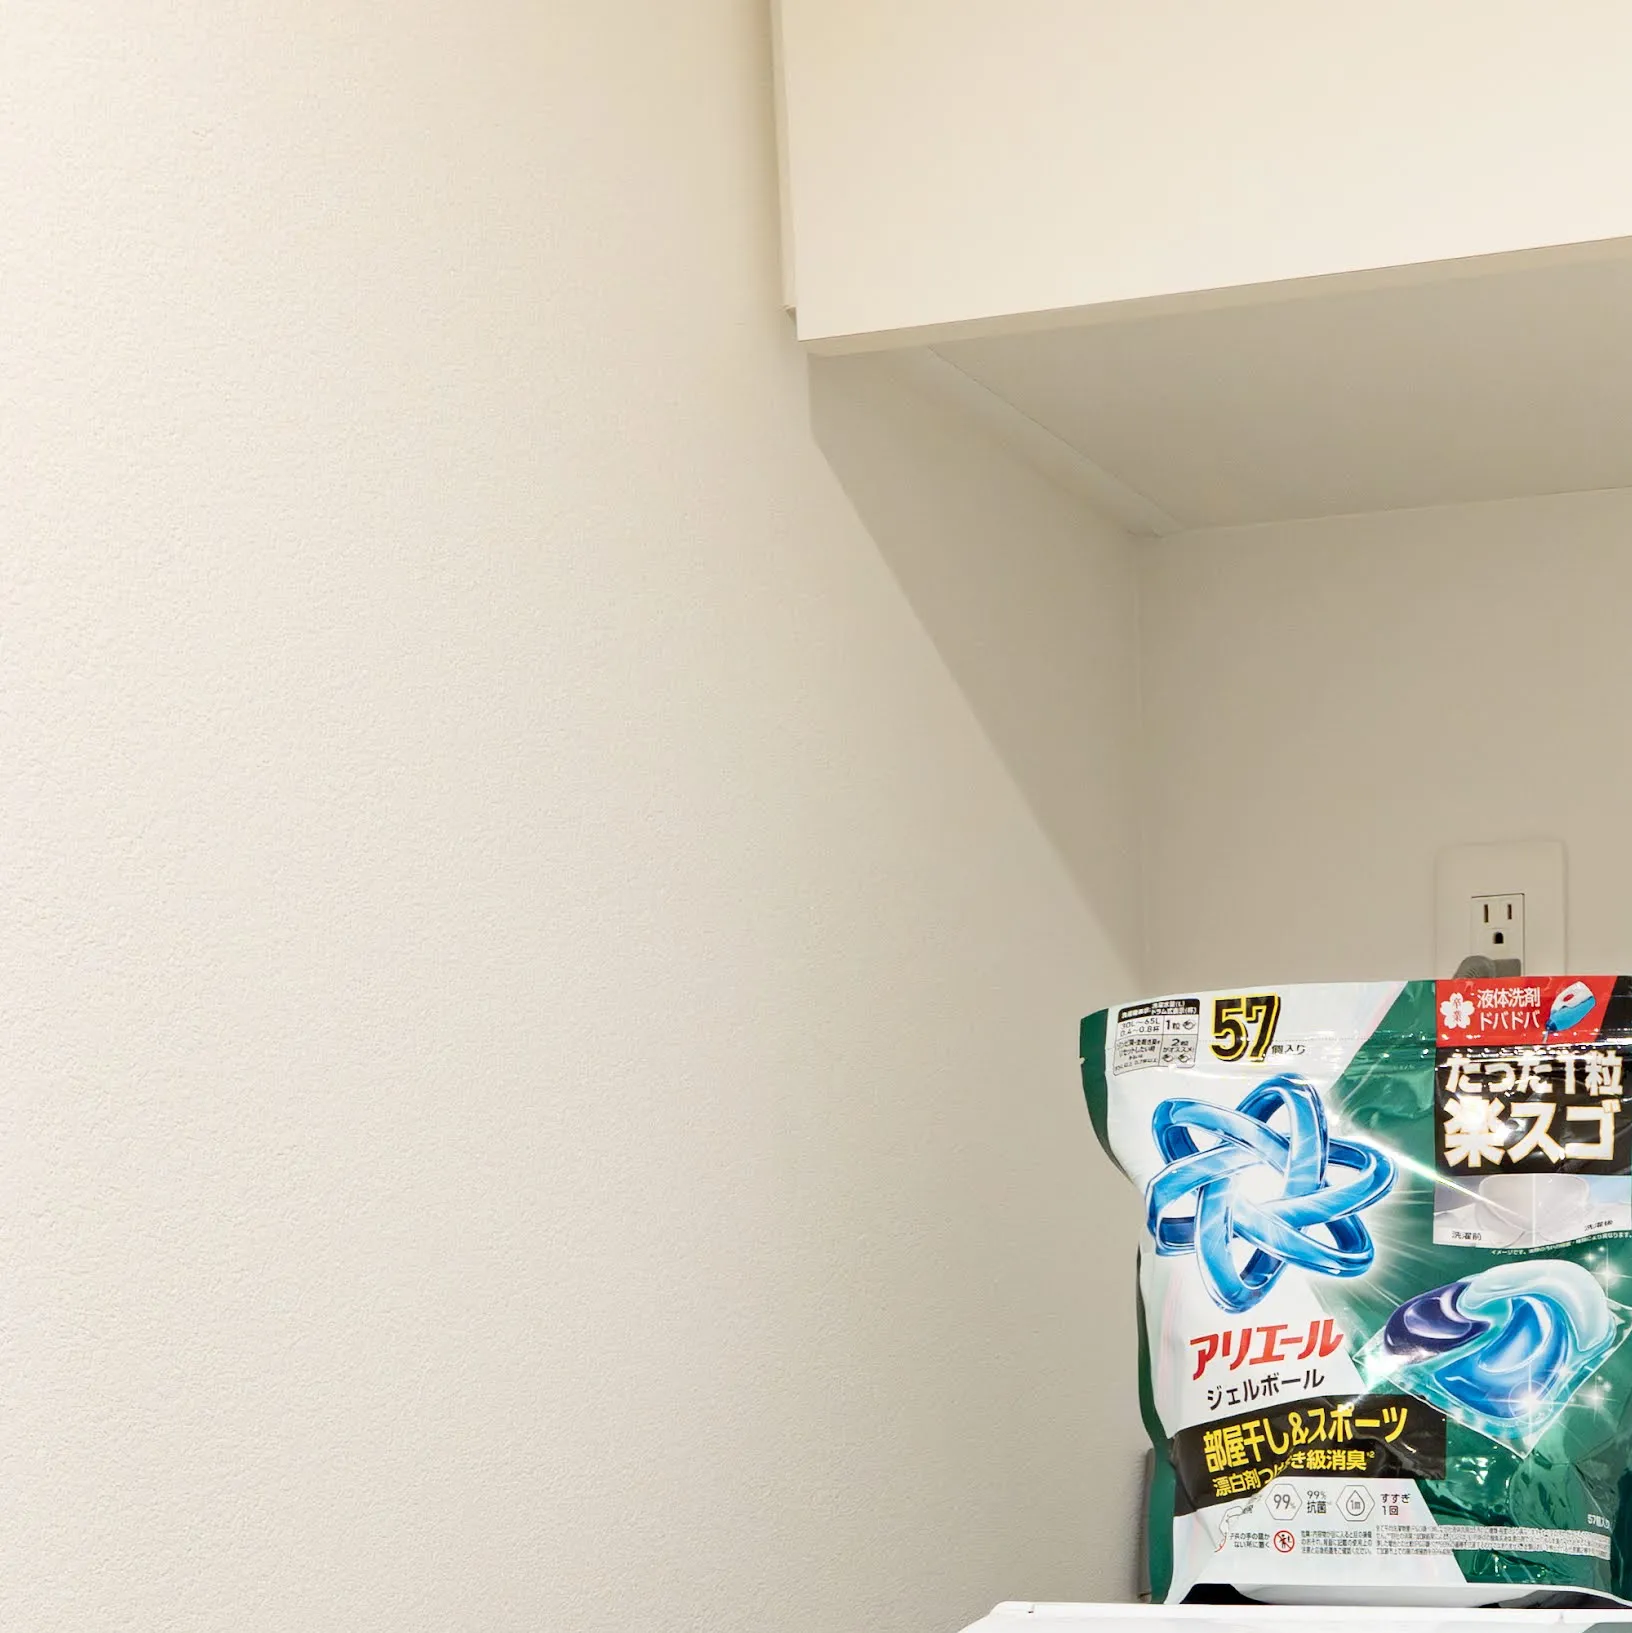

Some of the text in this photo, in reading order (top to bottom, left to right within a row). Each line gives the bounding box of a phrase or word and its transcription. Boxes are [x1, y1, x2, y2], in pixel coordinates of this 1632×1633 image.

[1476, 987, 1541, 1009] 液体洗剤
[1479, 1009, 1540, 1031] ドバドバ
[1211, 992, 1282, 1063] 57
[1445, 1049, 1623, 1097] たった1粒
[1443, 1096, 1622, 1168] 楽スゴ
[1189, 1318, 1345, 1381] アリエール
[1206, 1368, 1326, 1411] ジェルボール
[1202, 1403, 1409, 1474] 部屋干し&スポーツ
[1212, 1450, 1367, 1498] 漂白剤つき級消臭
[1306, 1500, 1327, 1514] 抗菌
[1380, 1492, 1411, 1504] すすぎ
[1381, 1505, 1399, 1516] 1回
